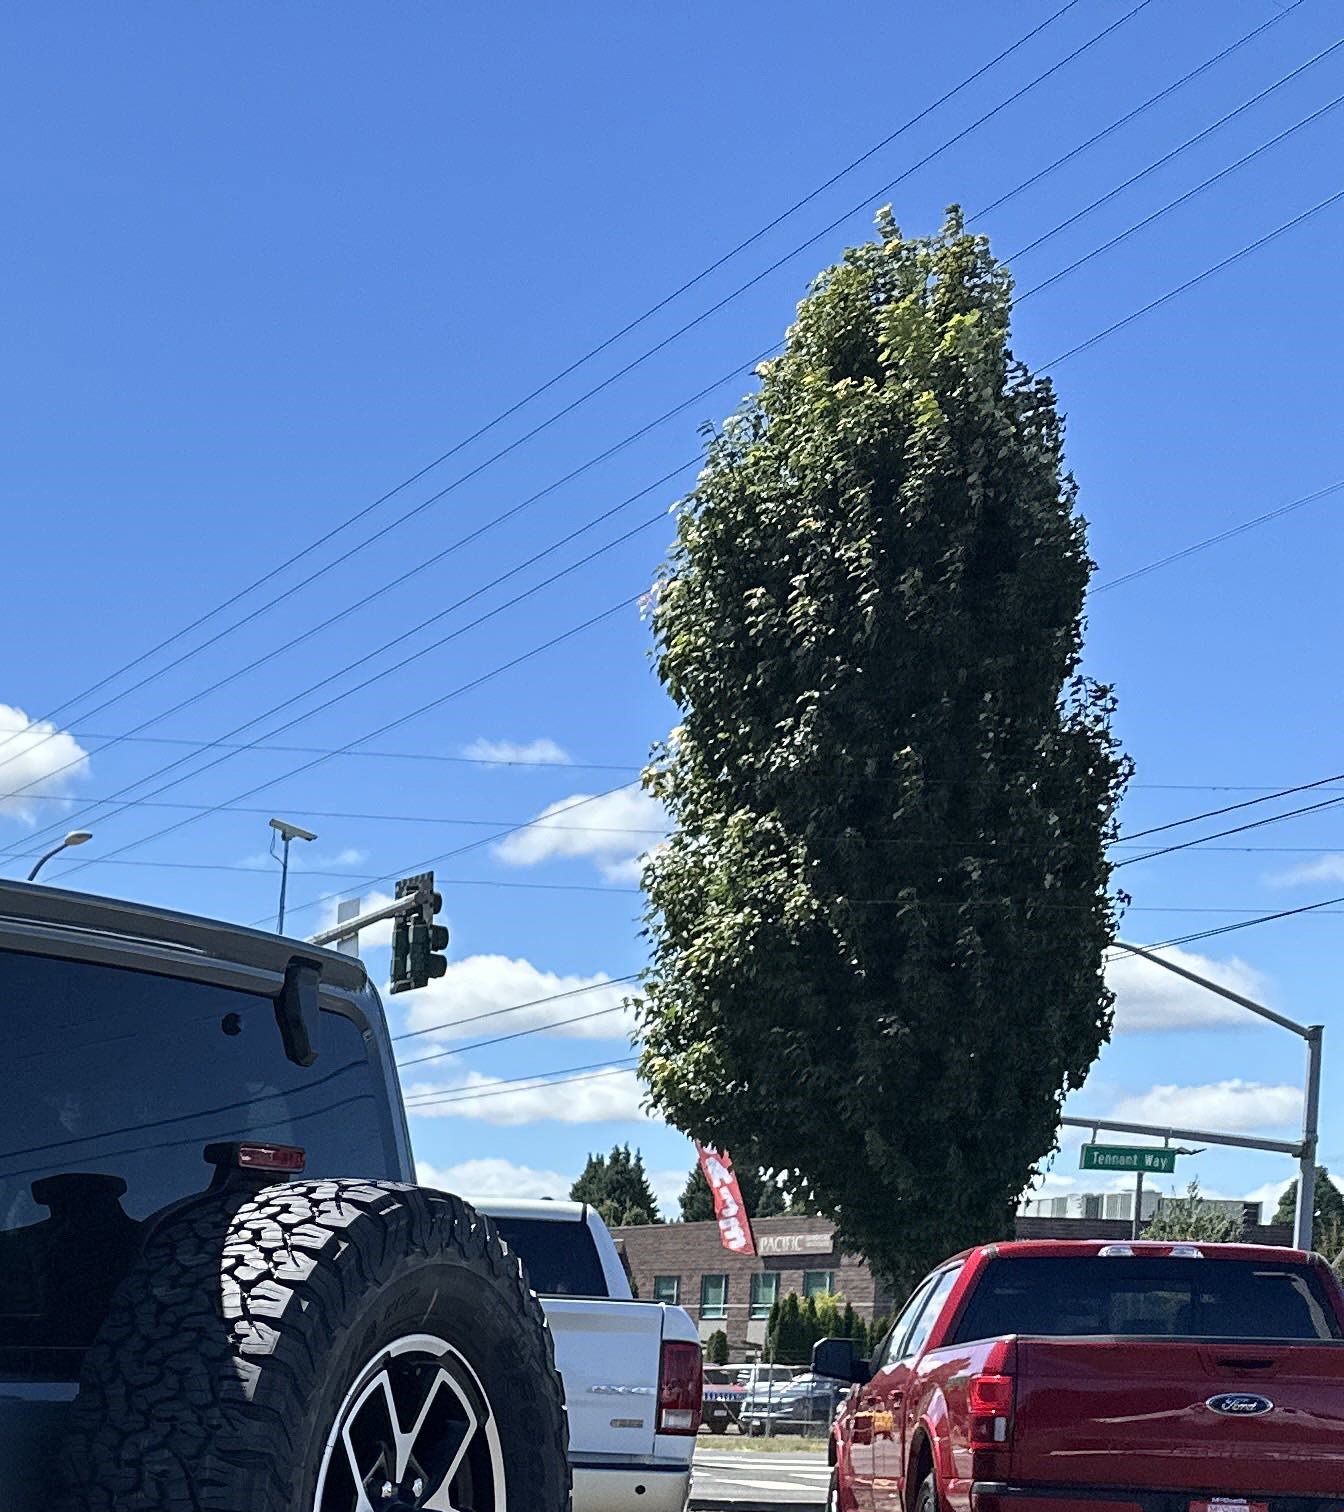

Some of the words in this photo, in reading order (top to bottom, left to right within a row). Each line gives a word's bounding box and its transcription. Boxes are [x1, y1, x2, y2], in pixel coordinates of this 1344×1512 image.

[1092, 1152, 1137, 1166] Tennant
[1145, 1154, 1168, 1169] Way
[759, 1235, 804, 1252] PACIFIC
[1221, 1398, 1257, 1411] Ford
